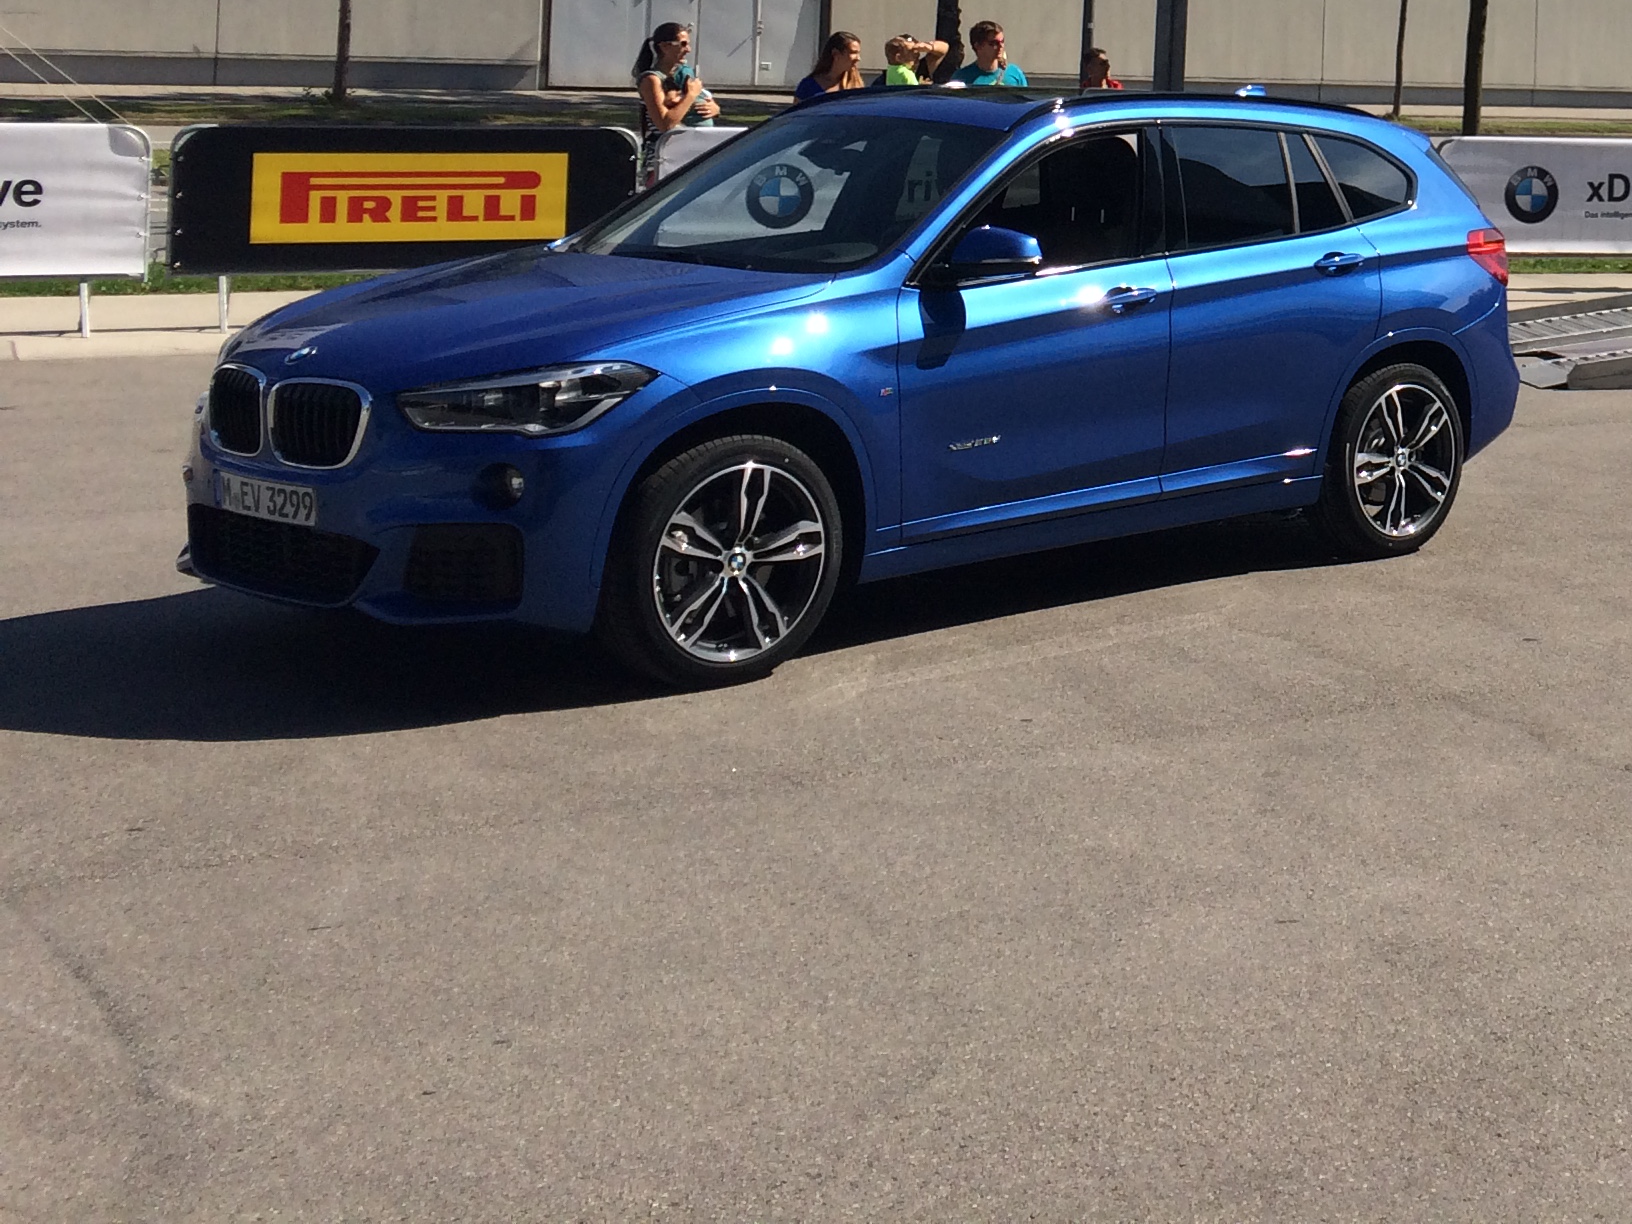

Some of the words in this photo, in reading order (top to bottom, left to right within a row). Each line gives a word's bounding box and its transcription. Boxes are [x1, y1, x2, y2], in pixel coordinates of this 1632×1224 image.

[1510, 168, 1556, 187] BMW
[279, 170, 542, 225] PIRELLI
[265, 486, 313, 522] 3299
